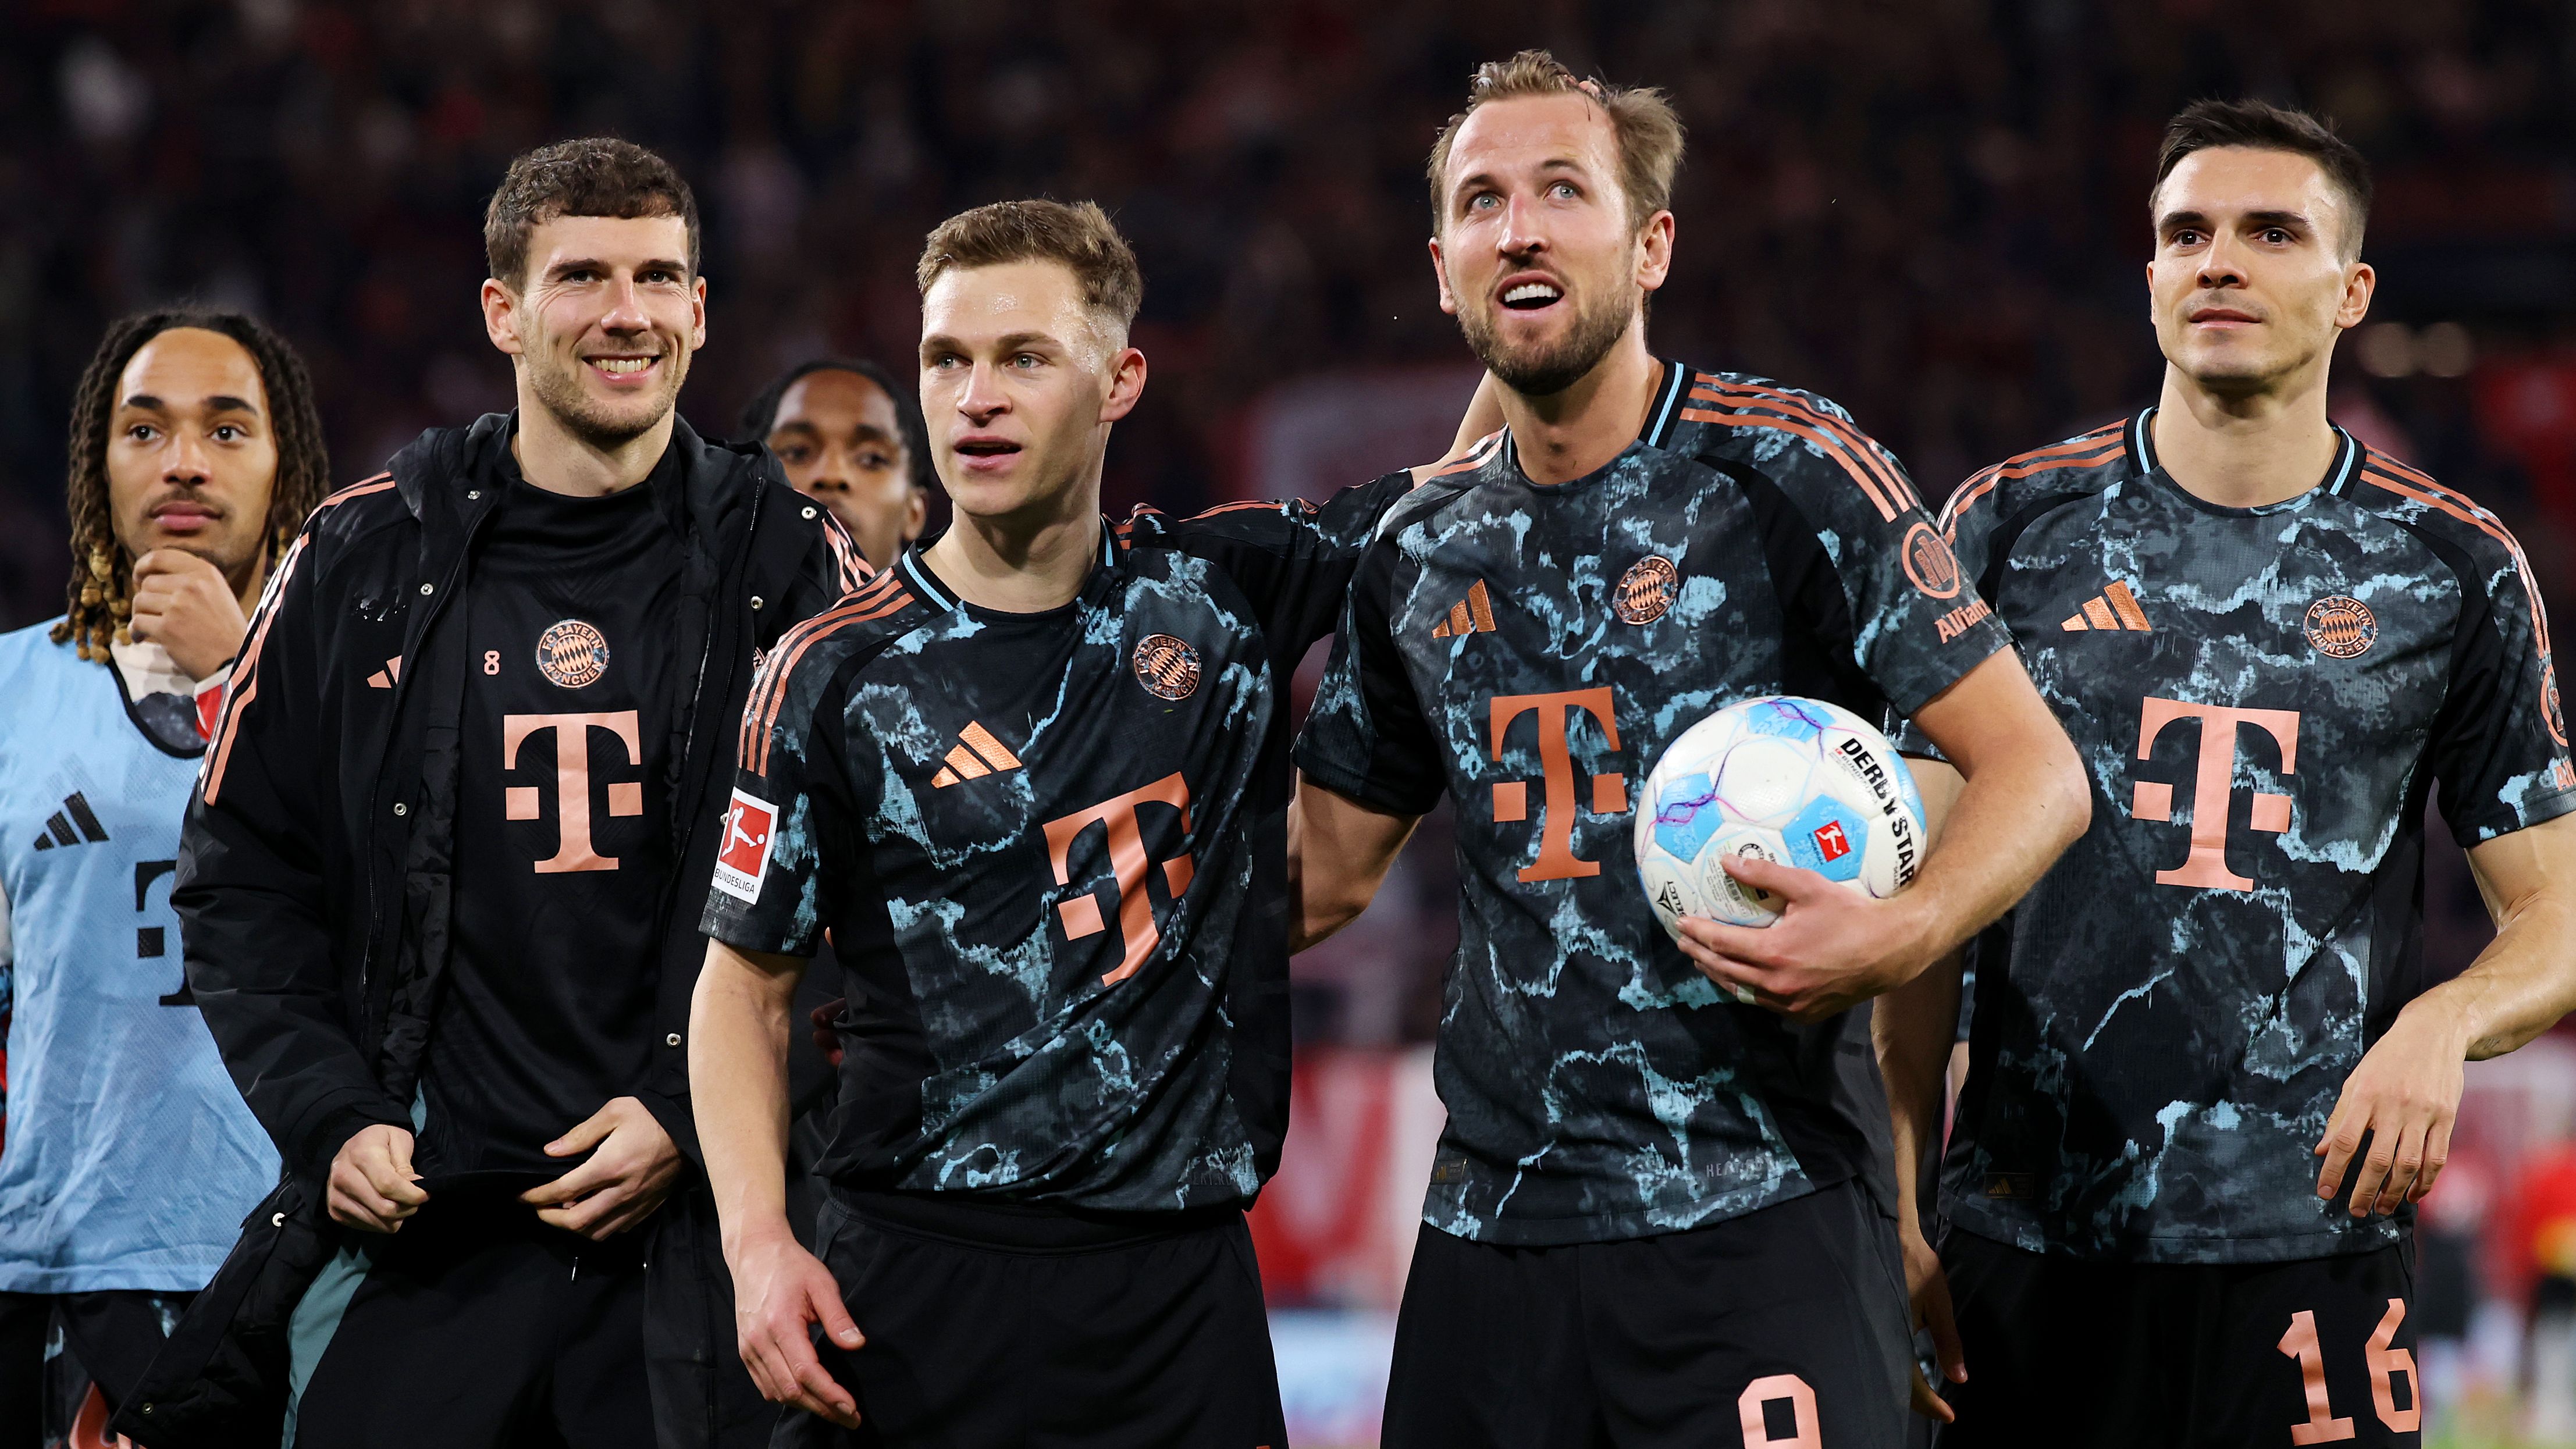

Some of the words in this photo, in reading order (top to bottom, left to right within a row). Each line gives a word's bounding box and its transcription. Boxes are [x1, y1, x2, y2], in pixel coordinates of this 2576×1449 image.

[542, 634, 557, 650] FC
[556, 624, 603, 649] BAYERN
[2327, 599, 2372, 626] BAYERN
[485, 651, 500, 674] 8
[544, 660, 603, 685] MÜNCHEN
[504, 710, 643, 874] T
[1490, 686, 1628, 883] T
[2132, 697, 2300, 892] T
[714, 868, 755, 894] BUNDESLIGA
[1042, 772, 1193, 987] T
[2278, 1298, 2422, 1446] 16
